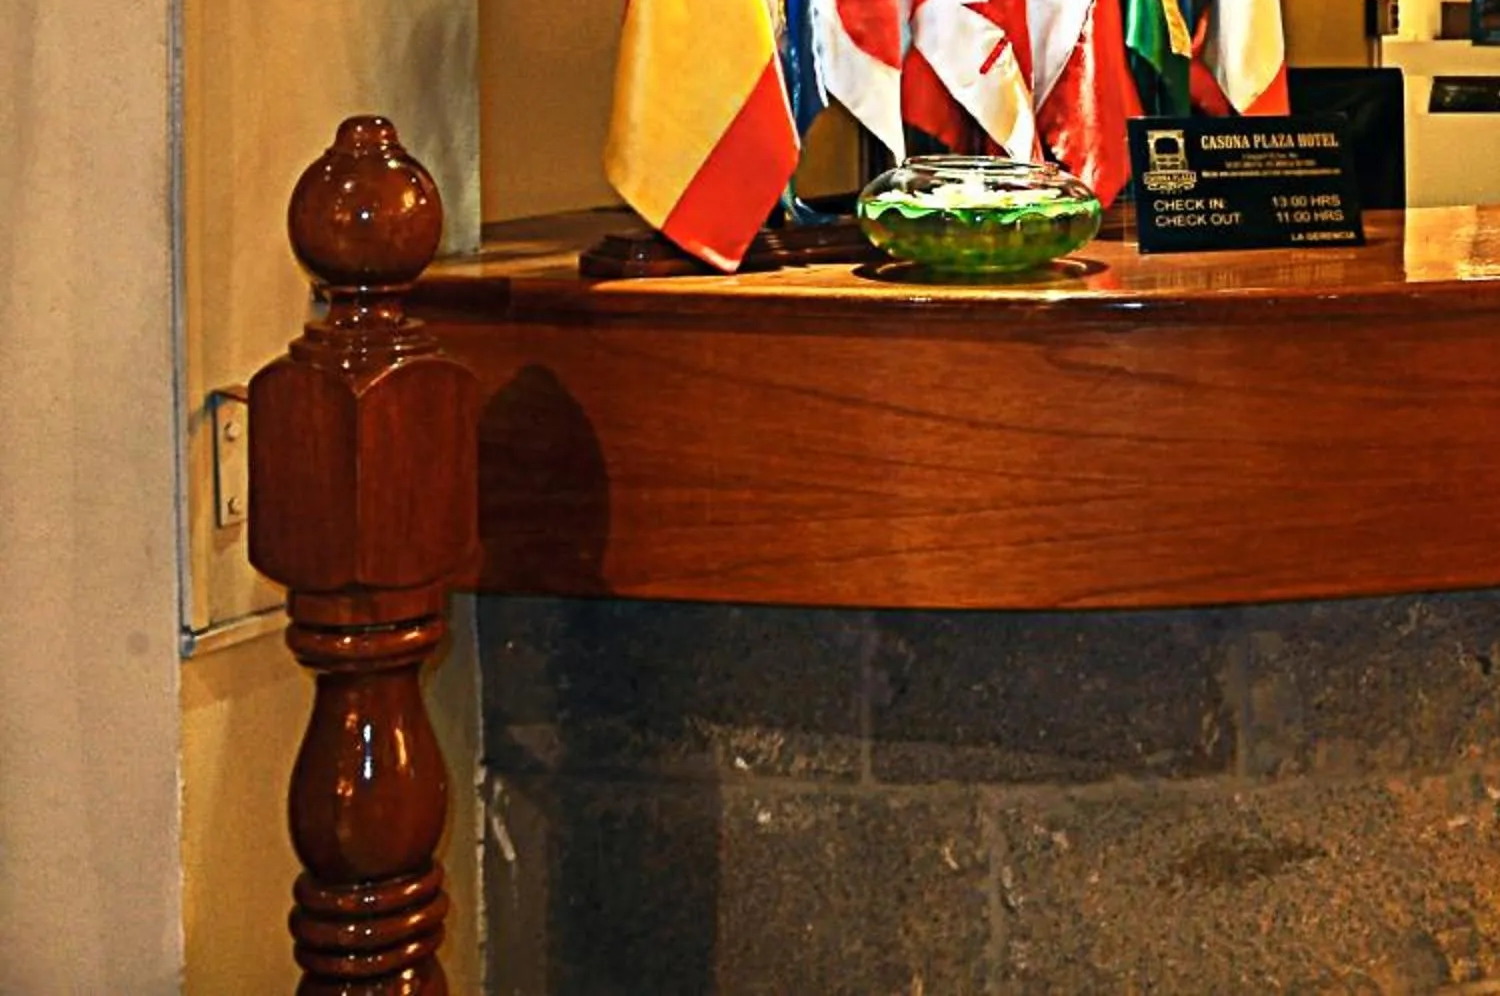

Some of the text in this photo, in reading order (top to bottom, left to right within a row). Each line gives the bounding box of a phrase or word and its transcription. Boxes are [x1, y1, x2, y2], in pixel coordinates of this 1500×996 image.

[1201, 132, 1339, 150] CASONA PLAZA HOTEL
[1153, 199, 1205, 212] CHECK
[1311, 194, 1341, 207] HRS
[1155, 212, 1242, 227] CHECK OUT
[1314, 209, 1345, 222] HRS
[1290, 231, 1356, 242] LA GERENCIA
